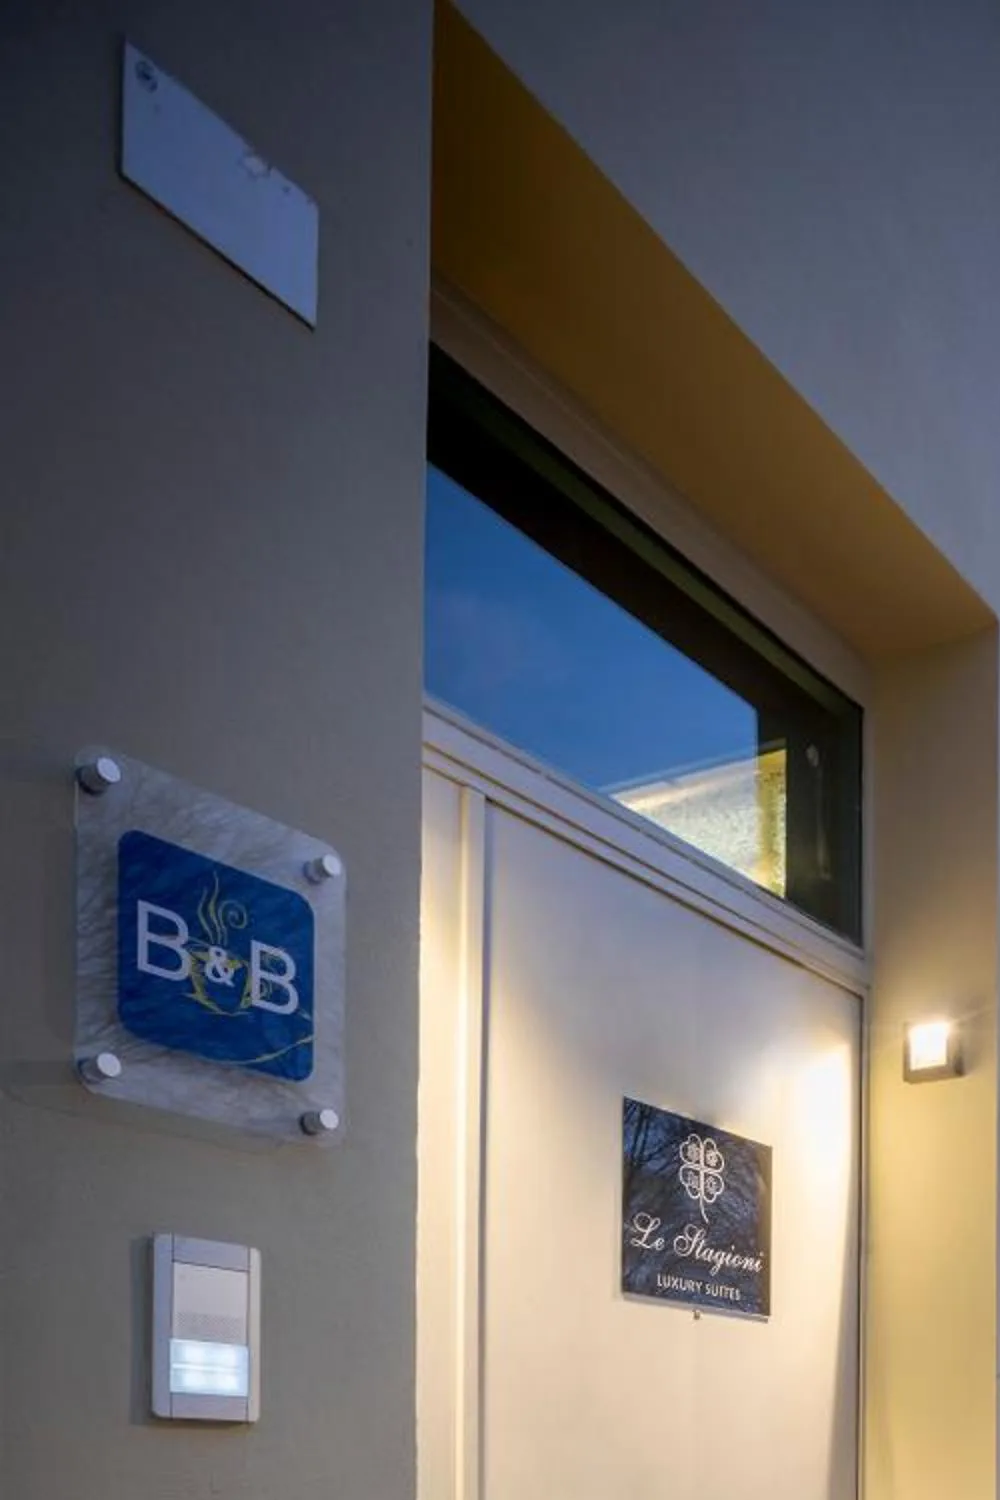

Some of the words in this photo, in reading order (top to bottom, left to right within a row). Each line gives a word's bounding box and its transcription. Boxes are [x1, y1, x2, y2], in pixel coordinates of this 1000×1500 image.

[137, 899, 299, 1016] B&B
[630, 1211, 665, 1251] Le
[673, 1223, 764, 1276] Stagioni
[656, 1272, 703, 1293] LUXURY
[704, 1283, 742, 1302] SUITES
